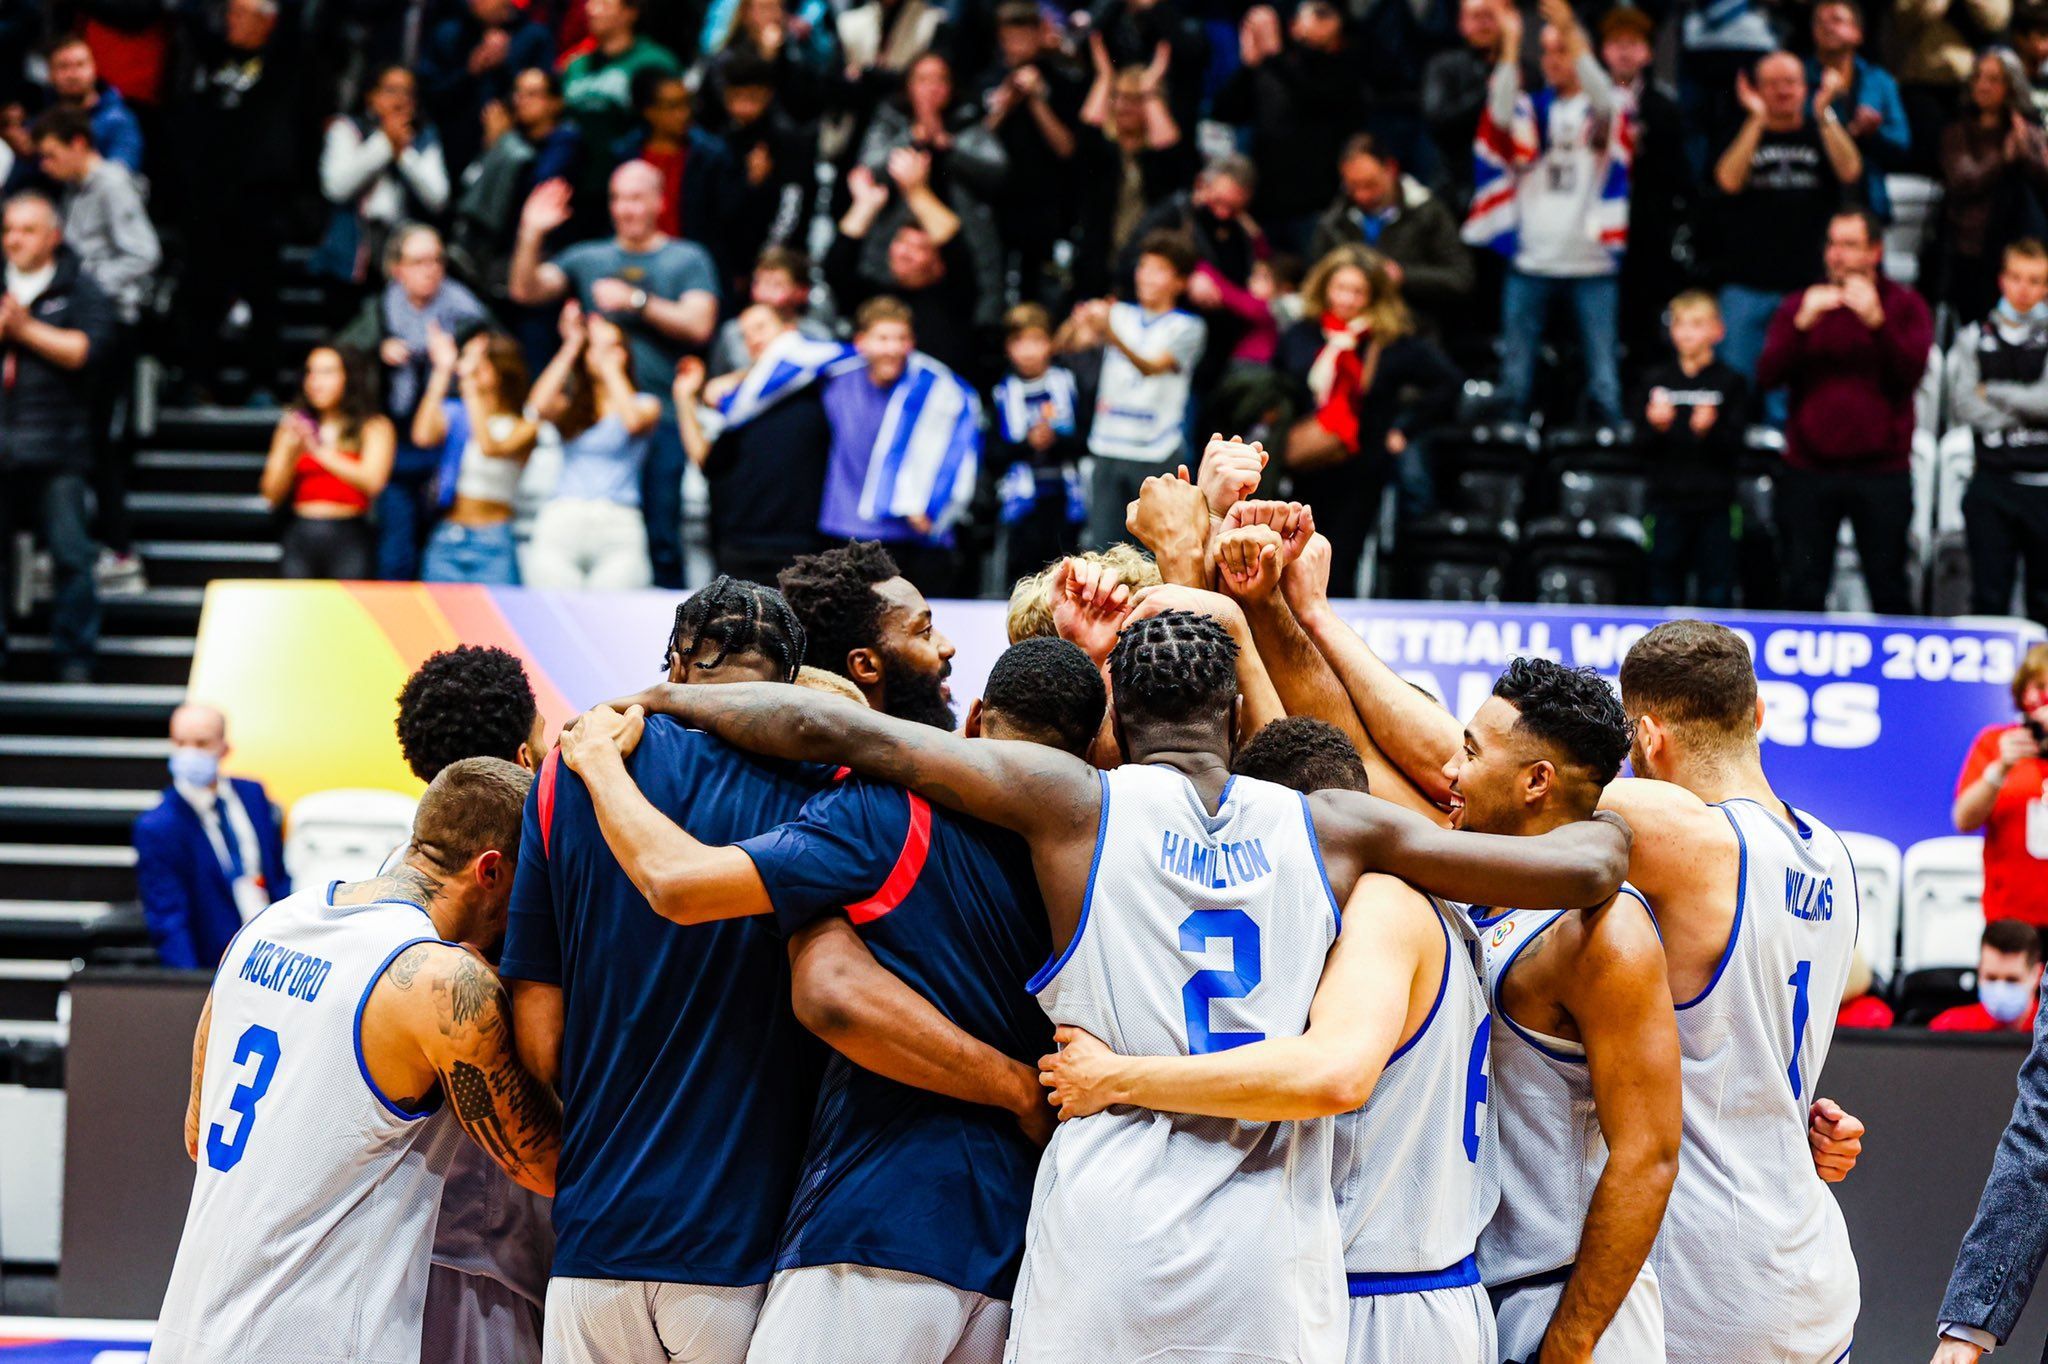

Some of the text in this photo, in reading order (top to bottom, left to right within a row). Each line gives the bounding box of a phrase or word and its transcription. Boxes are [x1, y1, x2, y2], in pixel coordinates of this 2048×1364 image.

[1764, 628, 1872, 677] CUP
[1881, 633, 2015, 684] 2023
[1160, 830, 1272, 889] HAMILTON
[239, 939, 332, 1003] MOCKFORD
[1178, 909, 1266, 1056] 2
[1787, 960, 1811, 1100] 1
[206, 1023, 281, 1173] 3
